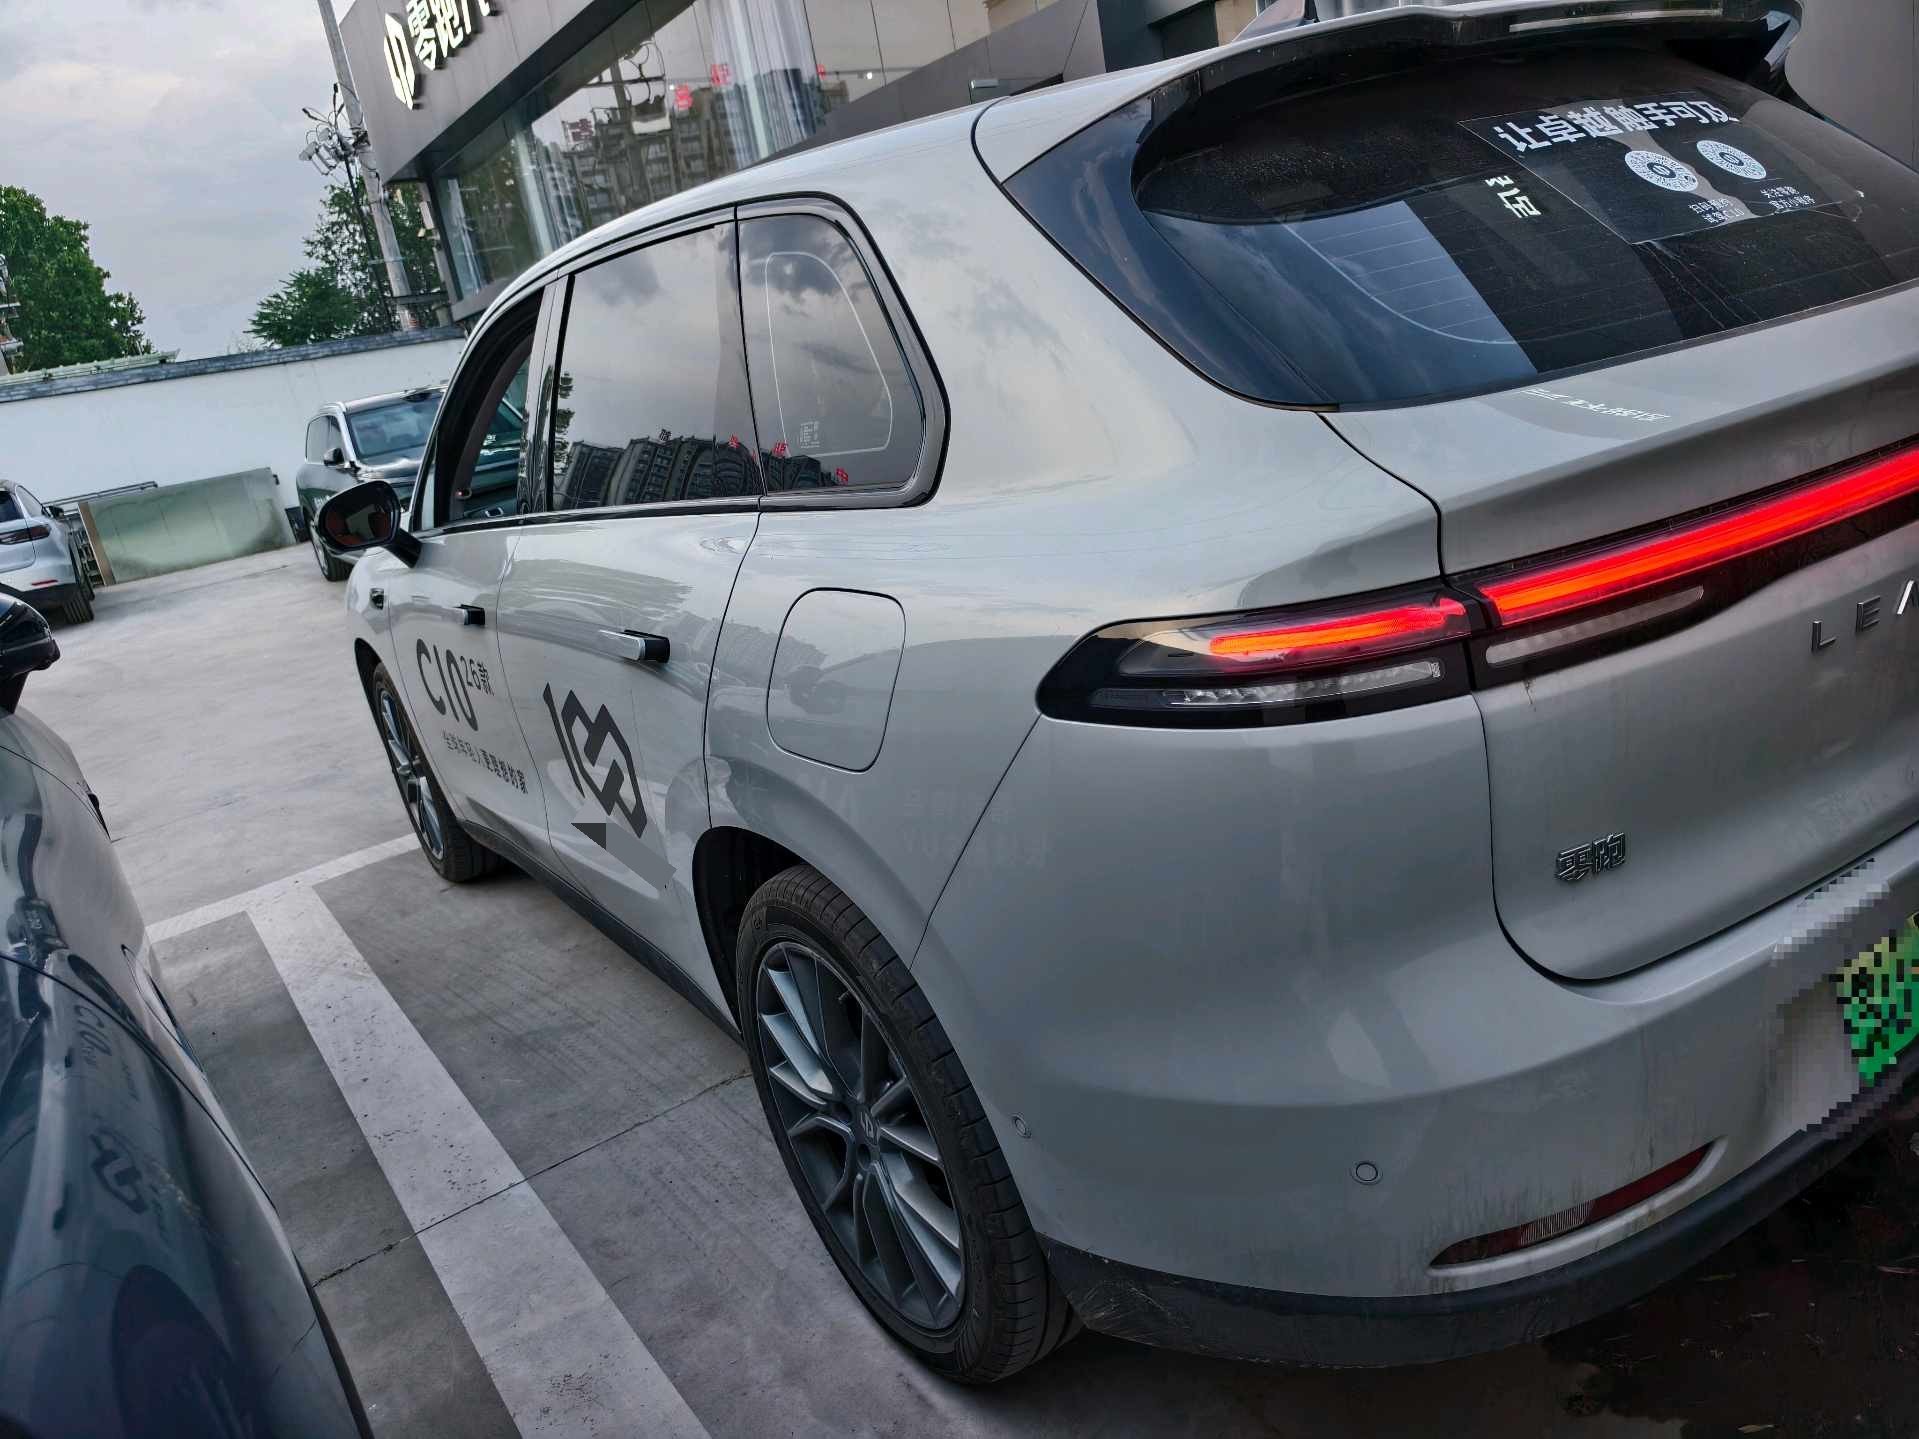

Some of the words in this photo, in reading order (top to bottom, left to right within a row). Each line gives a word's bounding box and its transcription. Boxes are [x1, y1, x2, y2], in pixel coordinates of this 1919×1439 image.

[1493, 100, 1740, 153] 让卓越触手可及
[416, 638, 479, 731] C10
[1556, 832, 1626, 880] 零跑
